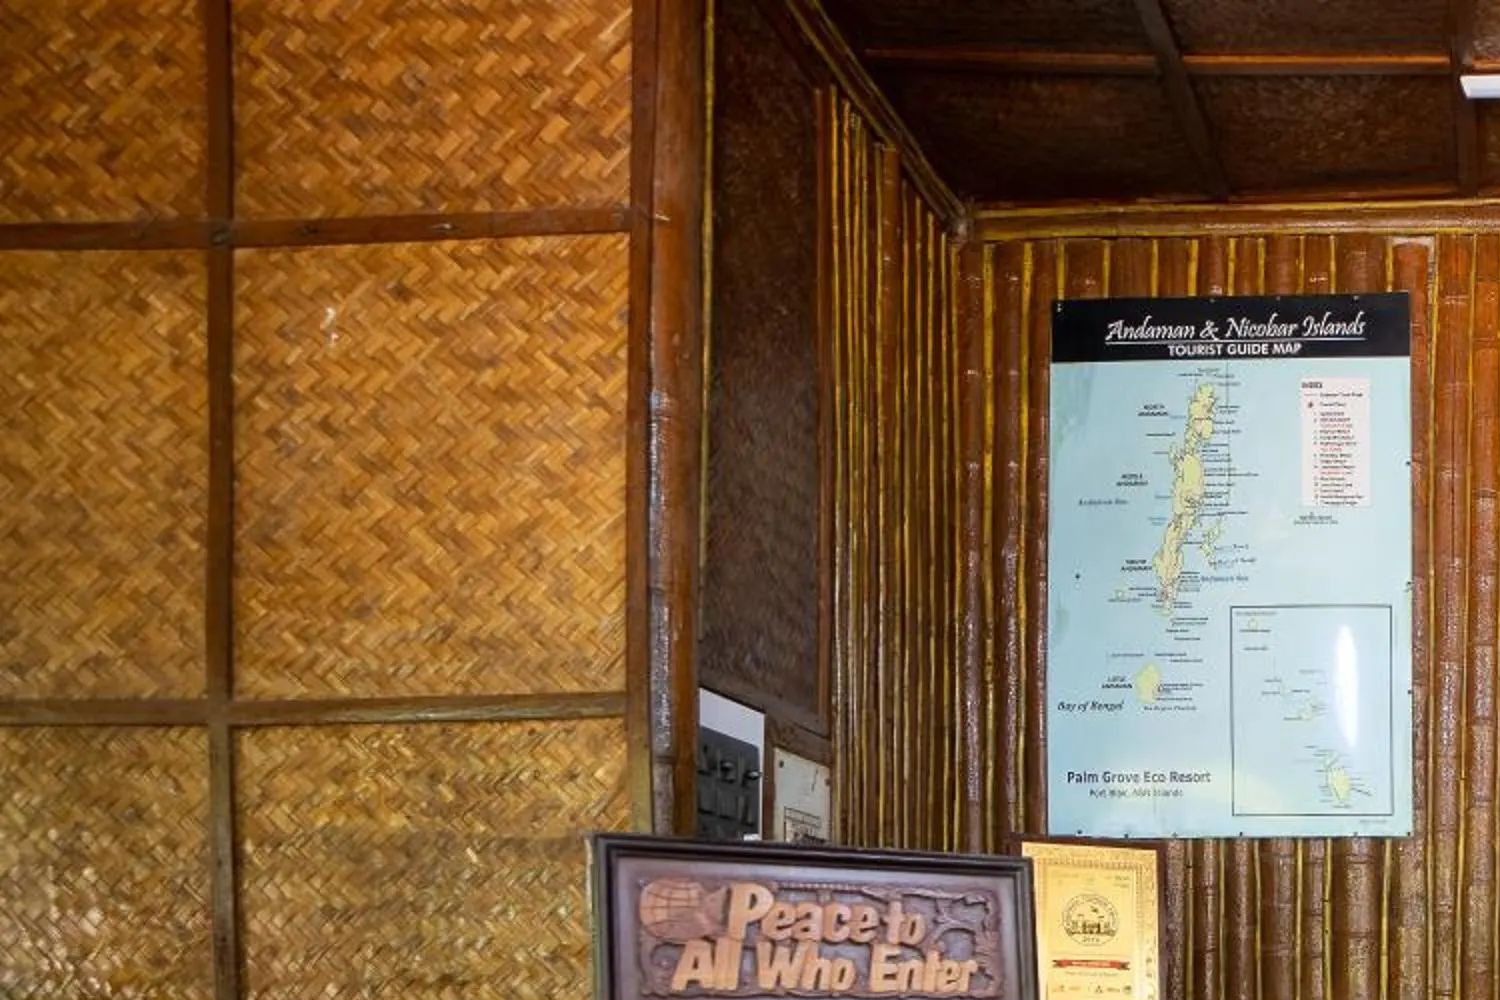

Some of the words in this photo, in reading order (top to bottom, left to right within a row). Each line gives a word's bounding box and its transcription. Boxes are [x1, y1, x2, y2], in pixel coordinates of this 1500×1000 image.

[1105, 315, 1196, 341] Andaman
[1199, 320, 1219, 341] &
[1225, 312, 1299, 338] Nicobar
[1302, 311, 1366, 337] Islands
[1168, 343, 1222, 356] TOURIST
[1227, 343, 1269, 355] GUIDE
[1272, 341, 1302, 355] MAP
[1067, 771, 1099, 784] Palm
[1102, 771, 1140, 783] Grove
[1143, 771, 1166, 783] Eco
[1169, 771, 1212, 783] Resort
[726, 883, 879, 943] Peace
[883, 901, 926, 946] to
[671, 935, 745, 991] All
[756, 936, 856, 992] Who
[869, 943, 978, 992] Enter
